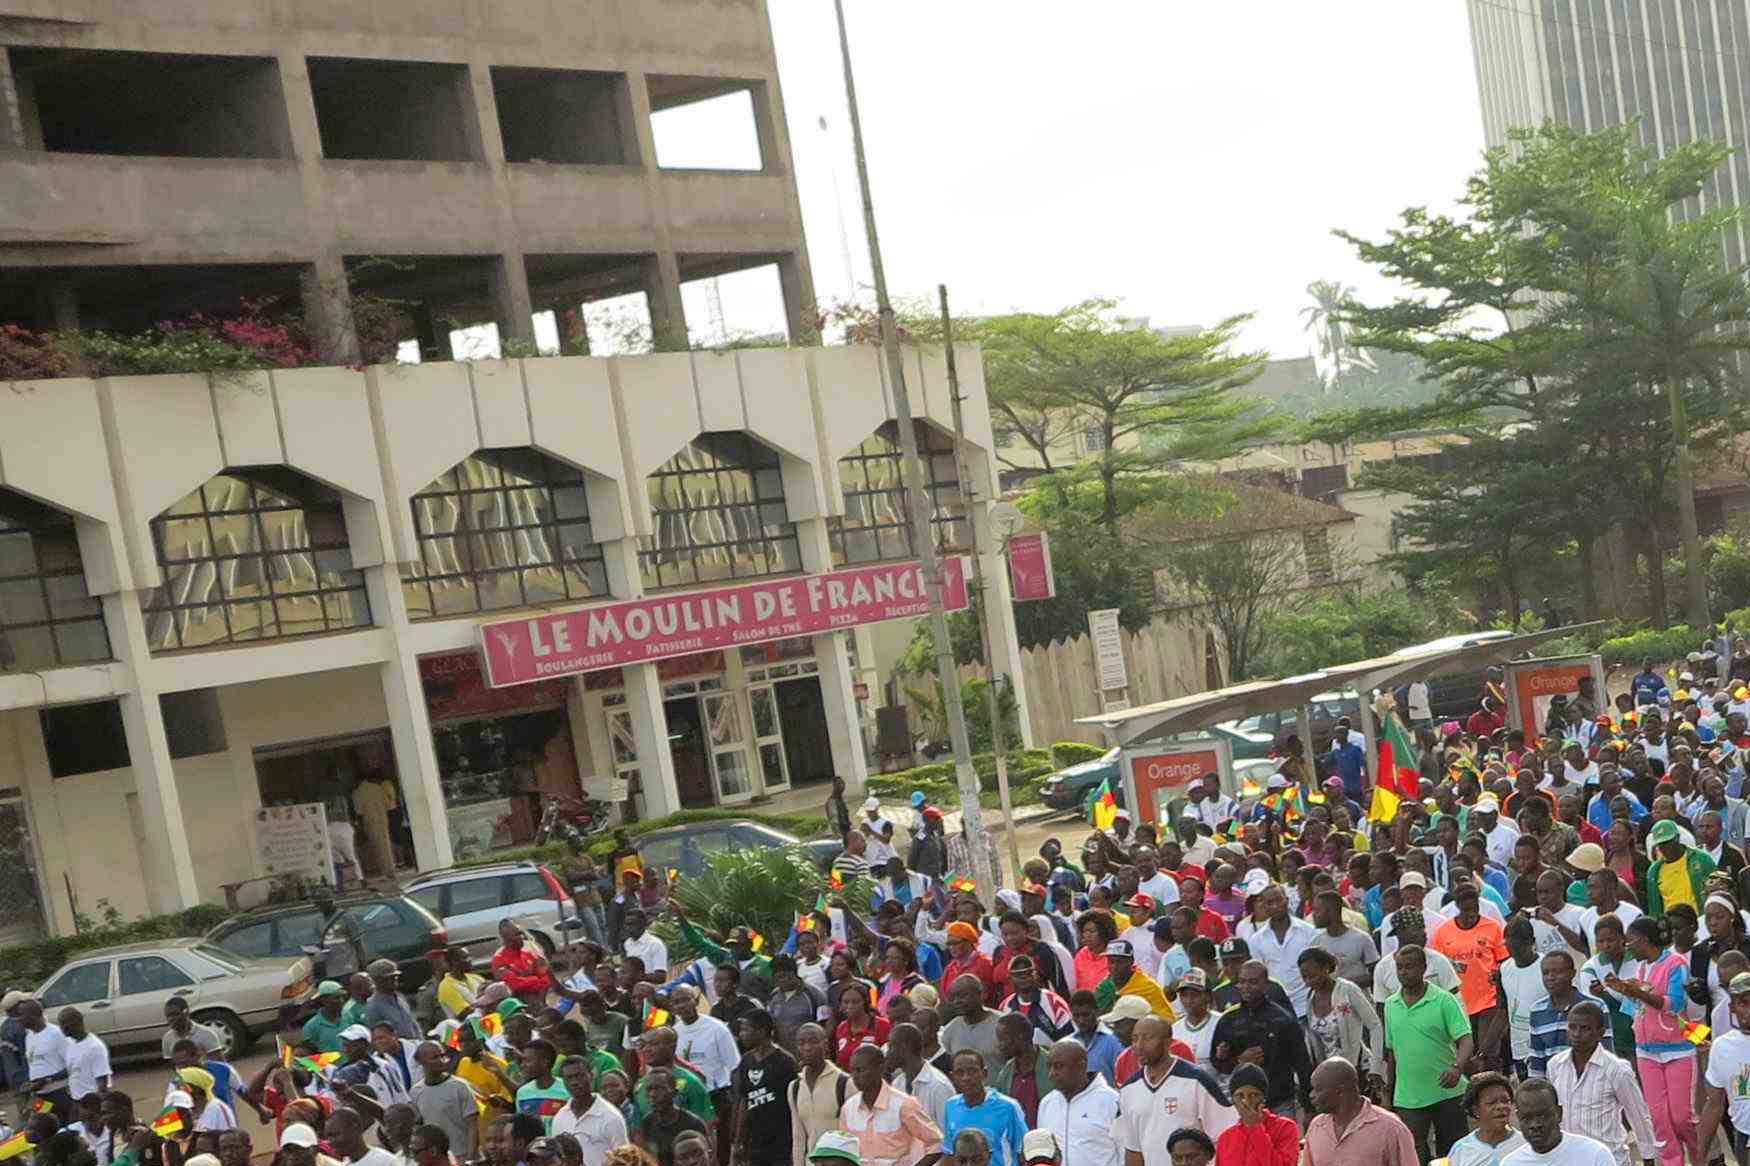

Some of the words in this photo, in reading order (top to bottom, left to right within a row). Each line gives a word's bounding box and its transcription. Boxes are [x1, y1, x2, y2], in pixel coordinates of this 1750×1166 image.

[527, 618, 572, 657] LE
[587, 594, 740, 648] MOULIN
[754, 586, 797, 621] DE
[536, 651, 614, 673] BOULANGERIE
[645, 636, 703, 655] PATISSERIE
[732, 627, 766, 641] SALON
[885, 602, 929, 617] RECEPTIO
[1530, 674, 1577, 691] Orange
[1147, 762, 1201, 780] Orange
